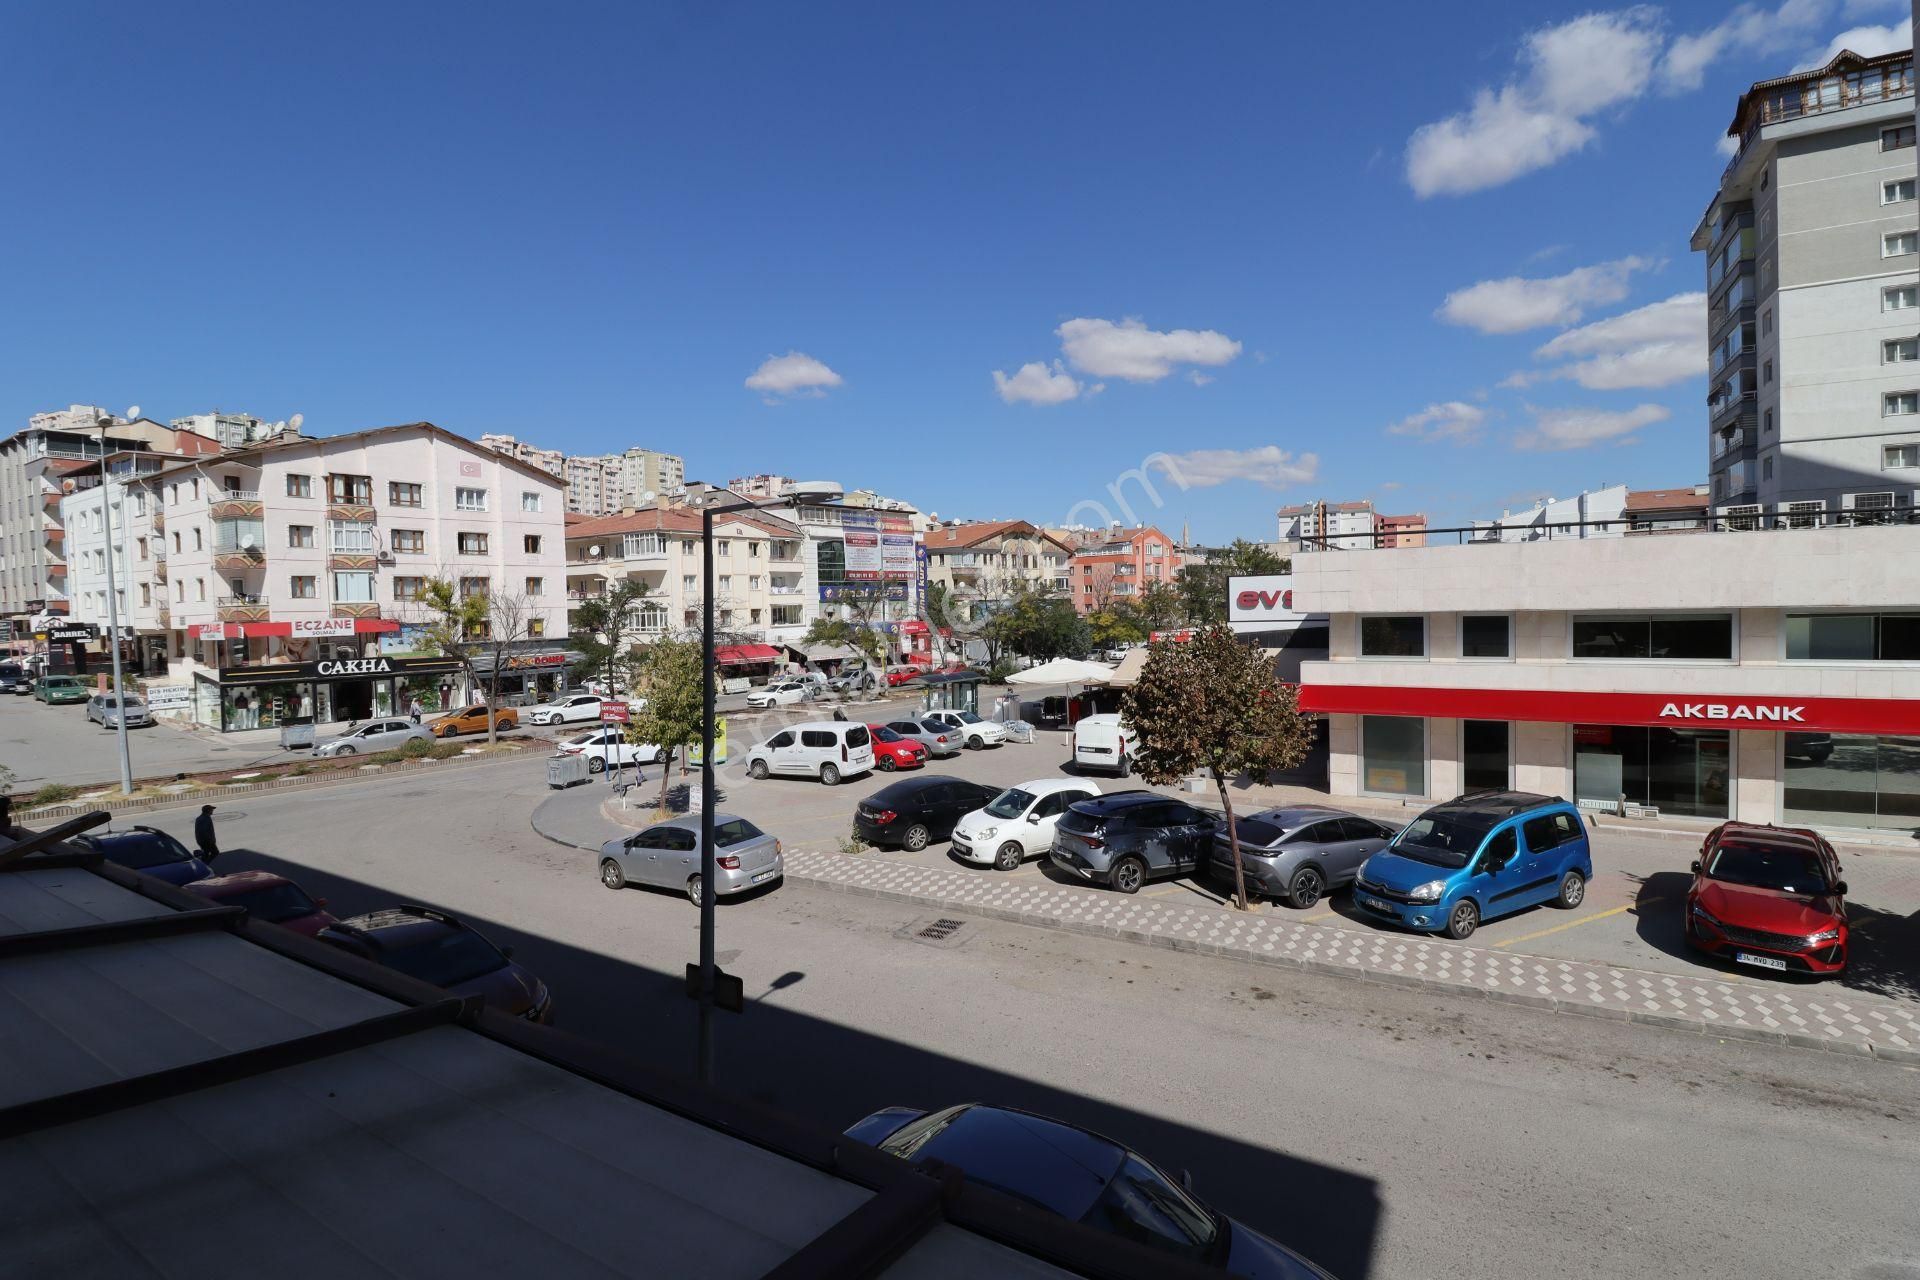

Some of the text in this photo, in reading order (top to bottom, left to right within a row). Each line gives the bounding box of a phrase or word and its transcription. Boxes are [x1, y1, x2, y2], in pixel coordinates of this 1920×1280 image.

[295, 619, 352, 631] ECZANE
[53, 630, 89, 638] BARREL
[317, 658, 392, 676] CAKHA
[1659, 703, 1806, 722] AKBANK
